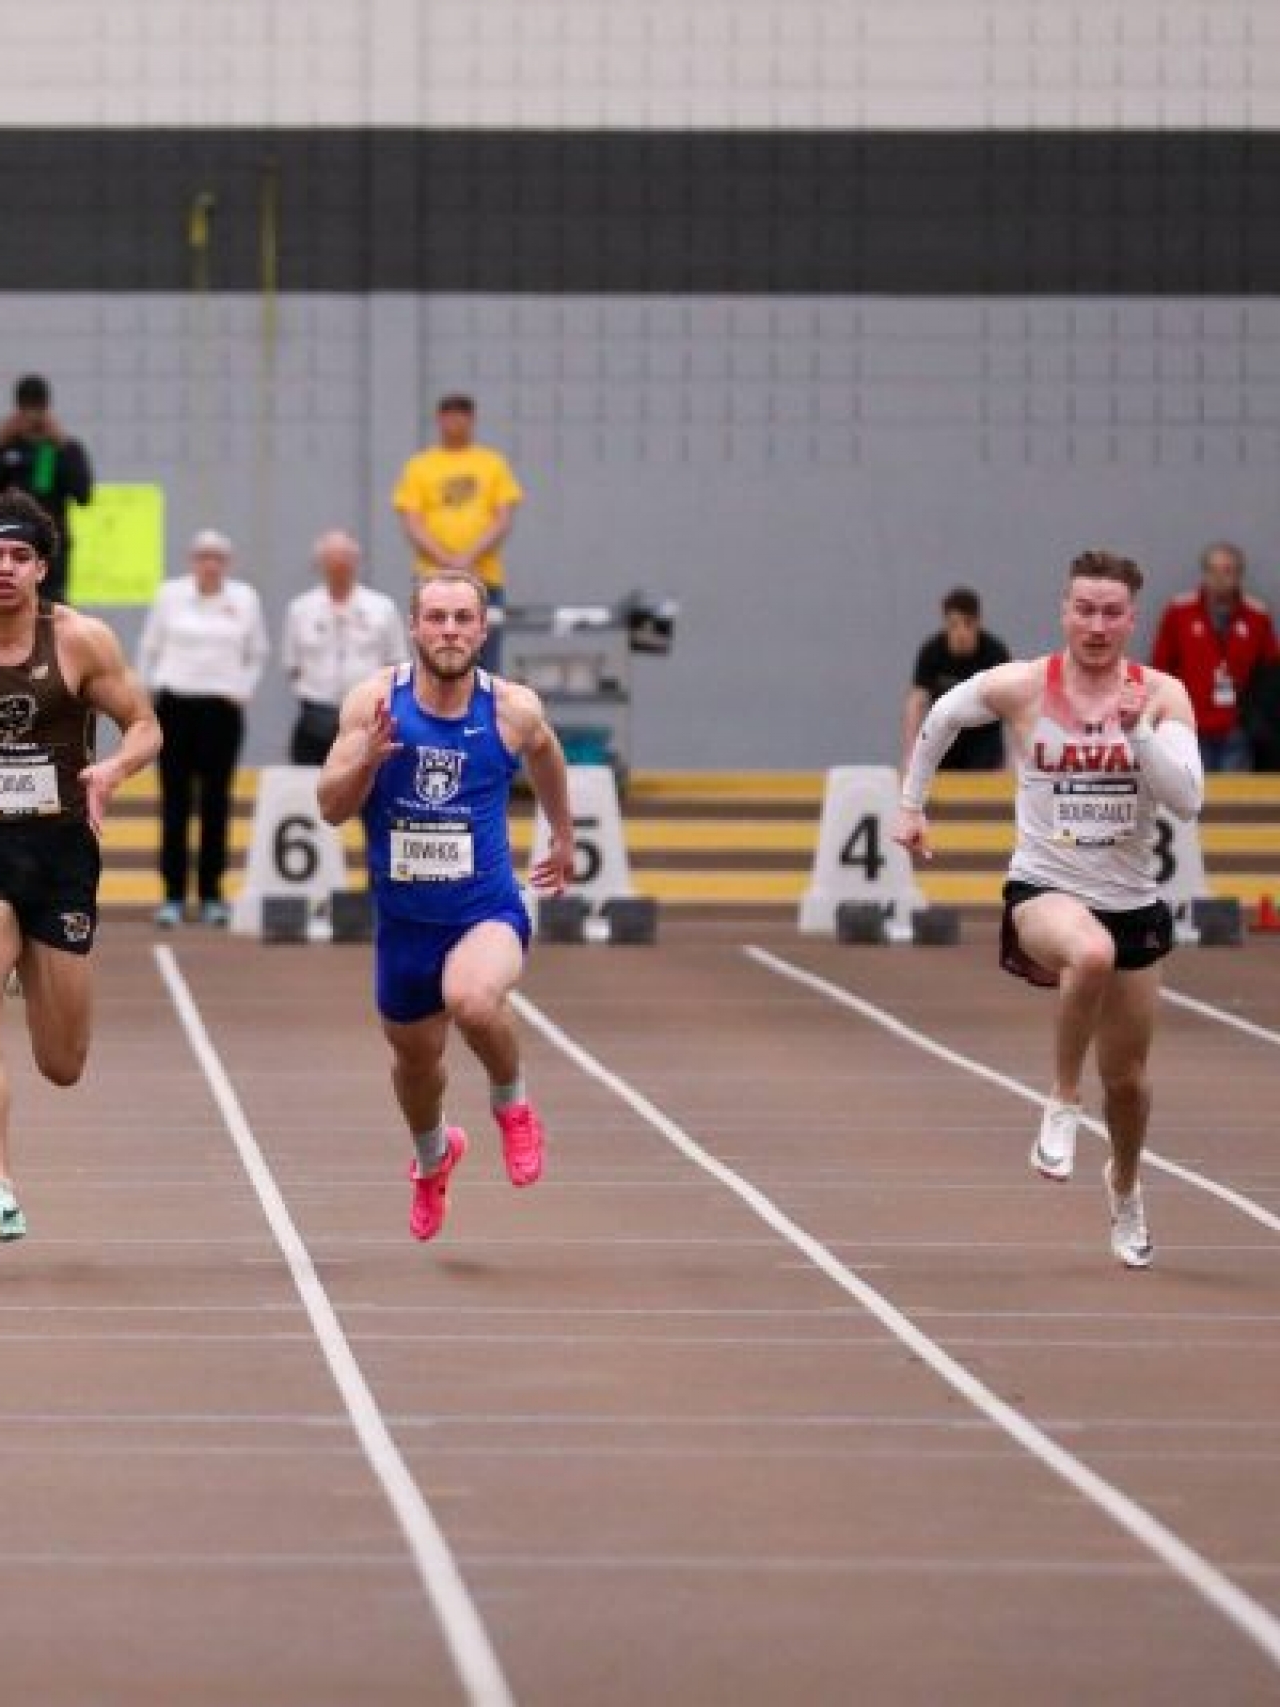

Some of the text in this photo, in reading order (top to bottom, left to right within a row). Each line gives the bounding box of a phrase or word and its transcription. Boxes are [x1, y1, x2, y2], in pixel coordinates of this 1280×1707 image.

[274, 814, 319, 884] 6
[571, 816, 603, 884] 5
[839, 812, 887, 883] 4
